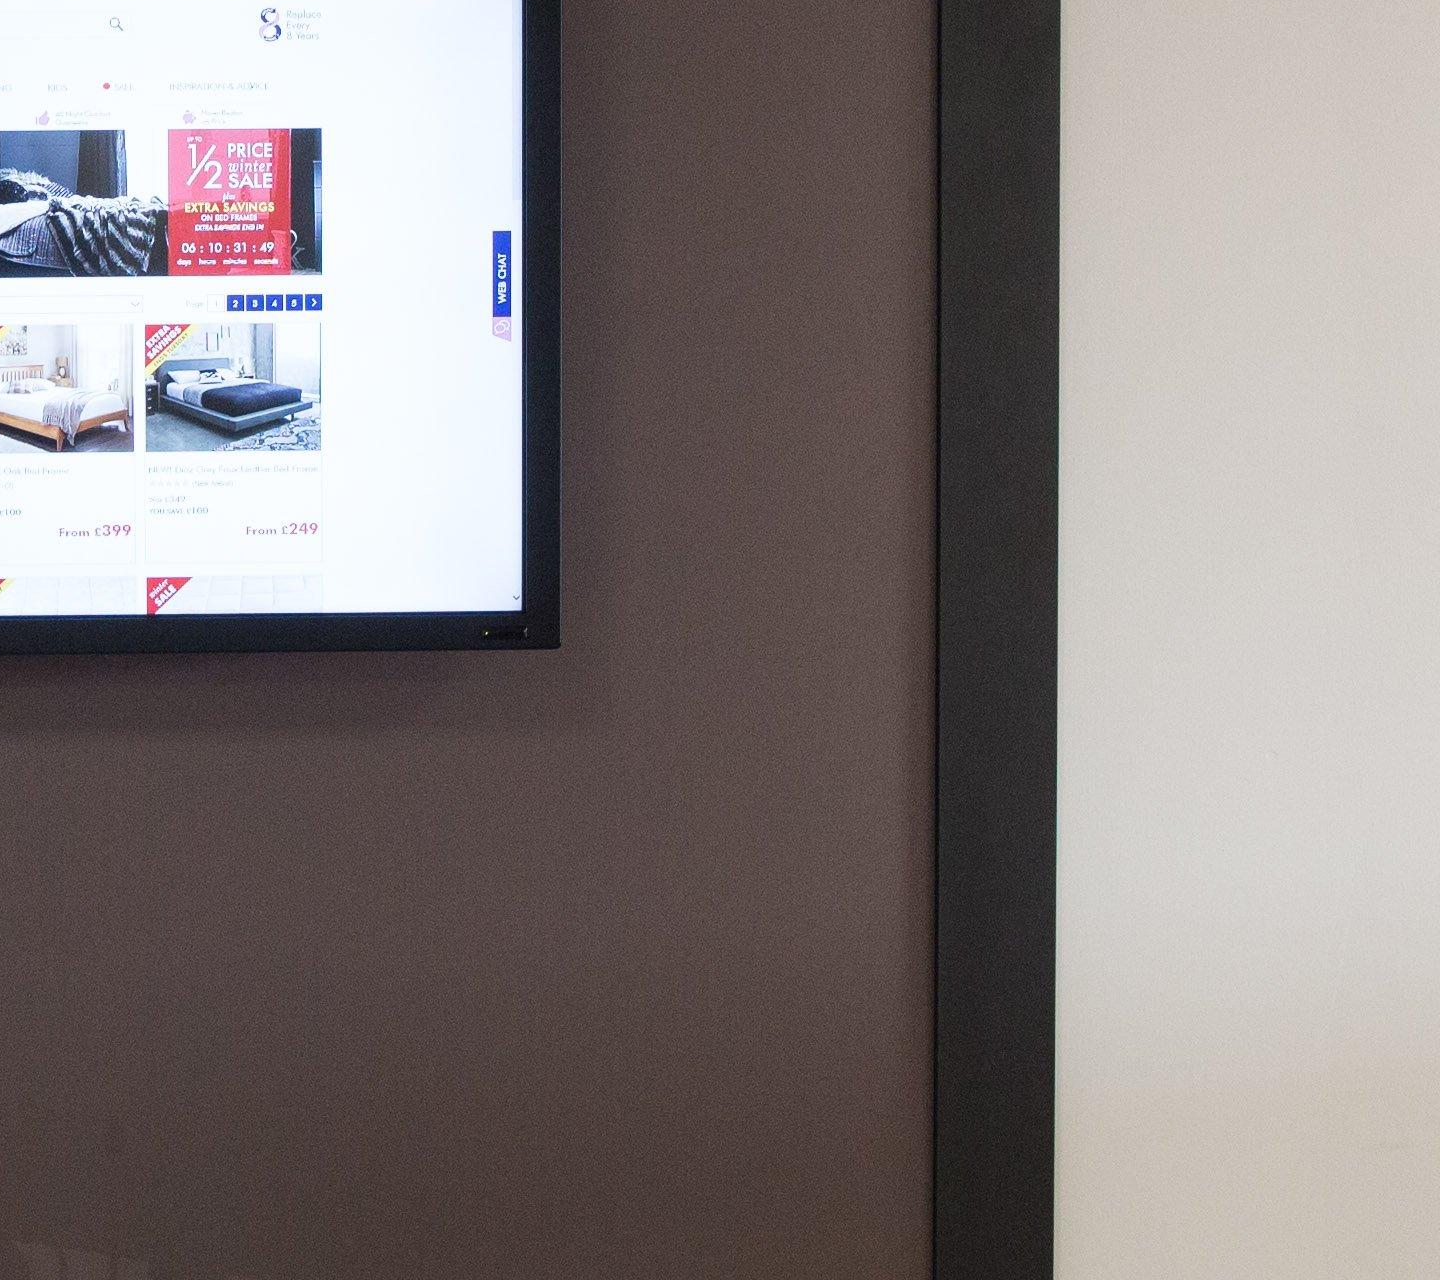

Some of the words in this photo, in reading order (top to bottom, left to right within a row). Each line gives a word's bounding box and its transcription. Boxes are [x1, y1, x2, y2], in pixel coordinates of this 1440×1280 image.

[286, 10, 322, 21] Replace
[286, 21, 310, 32] Every
[295, 31, 320, 41] Years
[227, 142, 273, 159] PRICE
[227, 159, 273, 173] winter
[228, 172, 273, 189] SALE
[184, 202, 220, 213] EXTRA
[223, 201, 275, 213] SAVINGS
[181, 242, 196, 254] 06
[208, 242, 223, 253] 10
[233, 242, 247, 253] 31
[259, 241, 275, 253] 49
[497, 252, 507, 280] CHAT
[497, 281, 507, 305] WEB
[146, 325, 183, 360] SAVINGS
[59, 527, 90, 538] From
[94, 524, 132, 537] £399
[246, 526, 277, 536] From
[281, 522, 319, 536] £249
